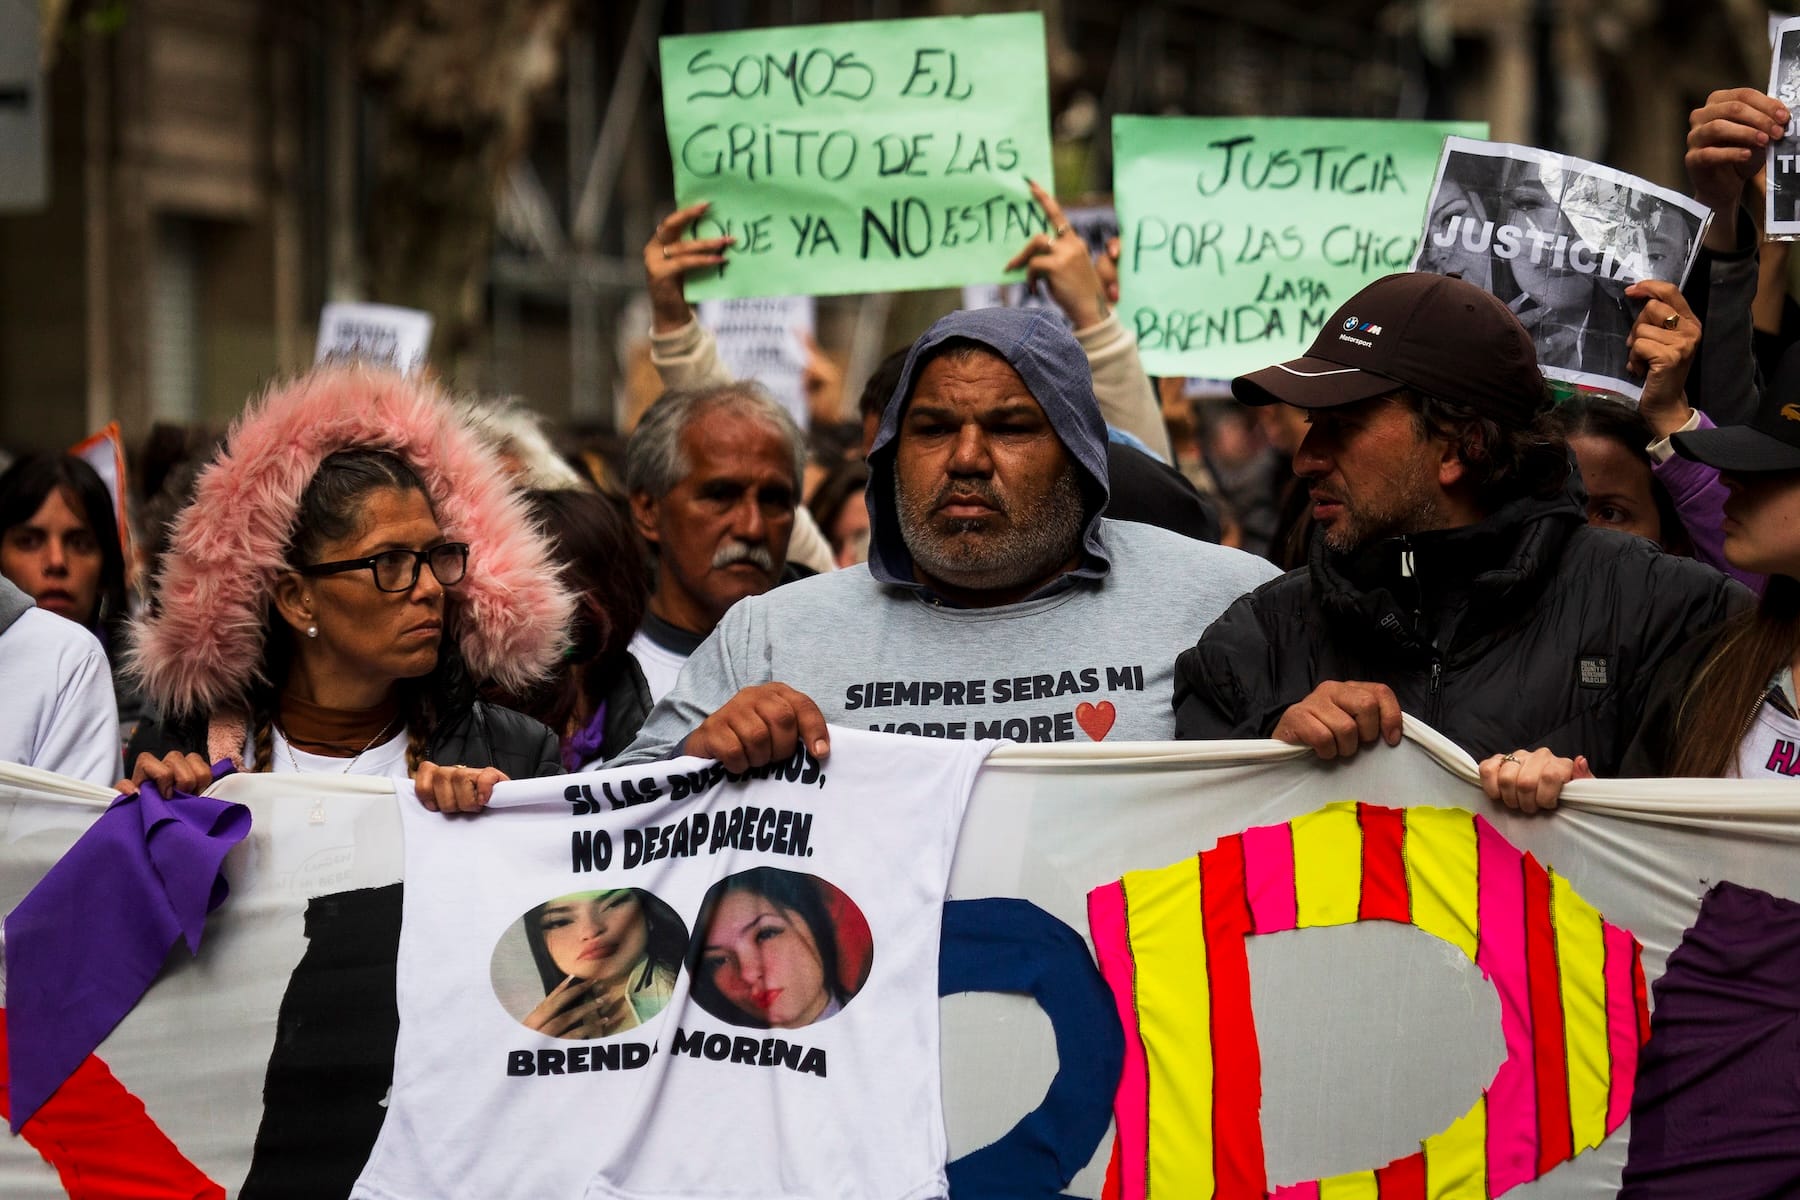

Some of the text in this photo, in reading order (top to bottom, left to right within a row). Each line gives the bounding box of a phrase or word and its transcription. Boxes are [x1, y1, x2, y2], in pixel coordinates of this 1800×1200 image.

[686, 48, 975, 105] SOMOS EL
[873, 132, 934, 178] DE
[945, 132, 1019, 176] LAS
[1197, 135, 1408, 198] JUSTICIA
[790, 214, 840, 258] YA
[860, 197, 933, 261] NO
[1133, 215, 1225, 275] POR
[1235, 218, 1304, 265] LAS
[1433, 216, 1652, 283] JUSTICIA
[1134, 303, 1285, 352] BRENDA
[845, 665, 1144, 710] SIEMPRE SERAS MI
[974, 711, 1075, 743] MORE
[564, 785, 600, 815] SI
[602, 777, 662, 811] LAS
[572, 806, 813, 873] NO DESAPARECEN.
[507, 1028, 827, 1077] BREND MORENA
